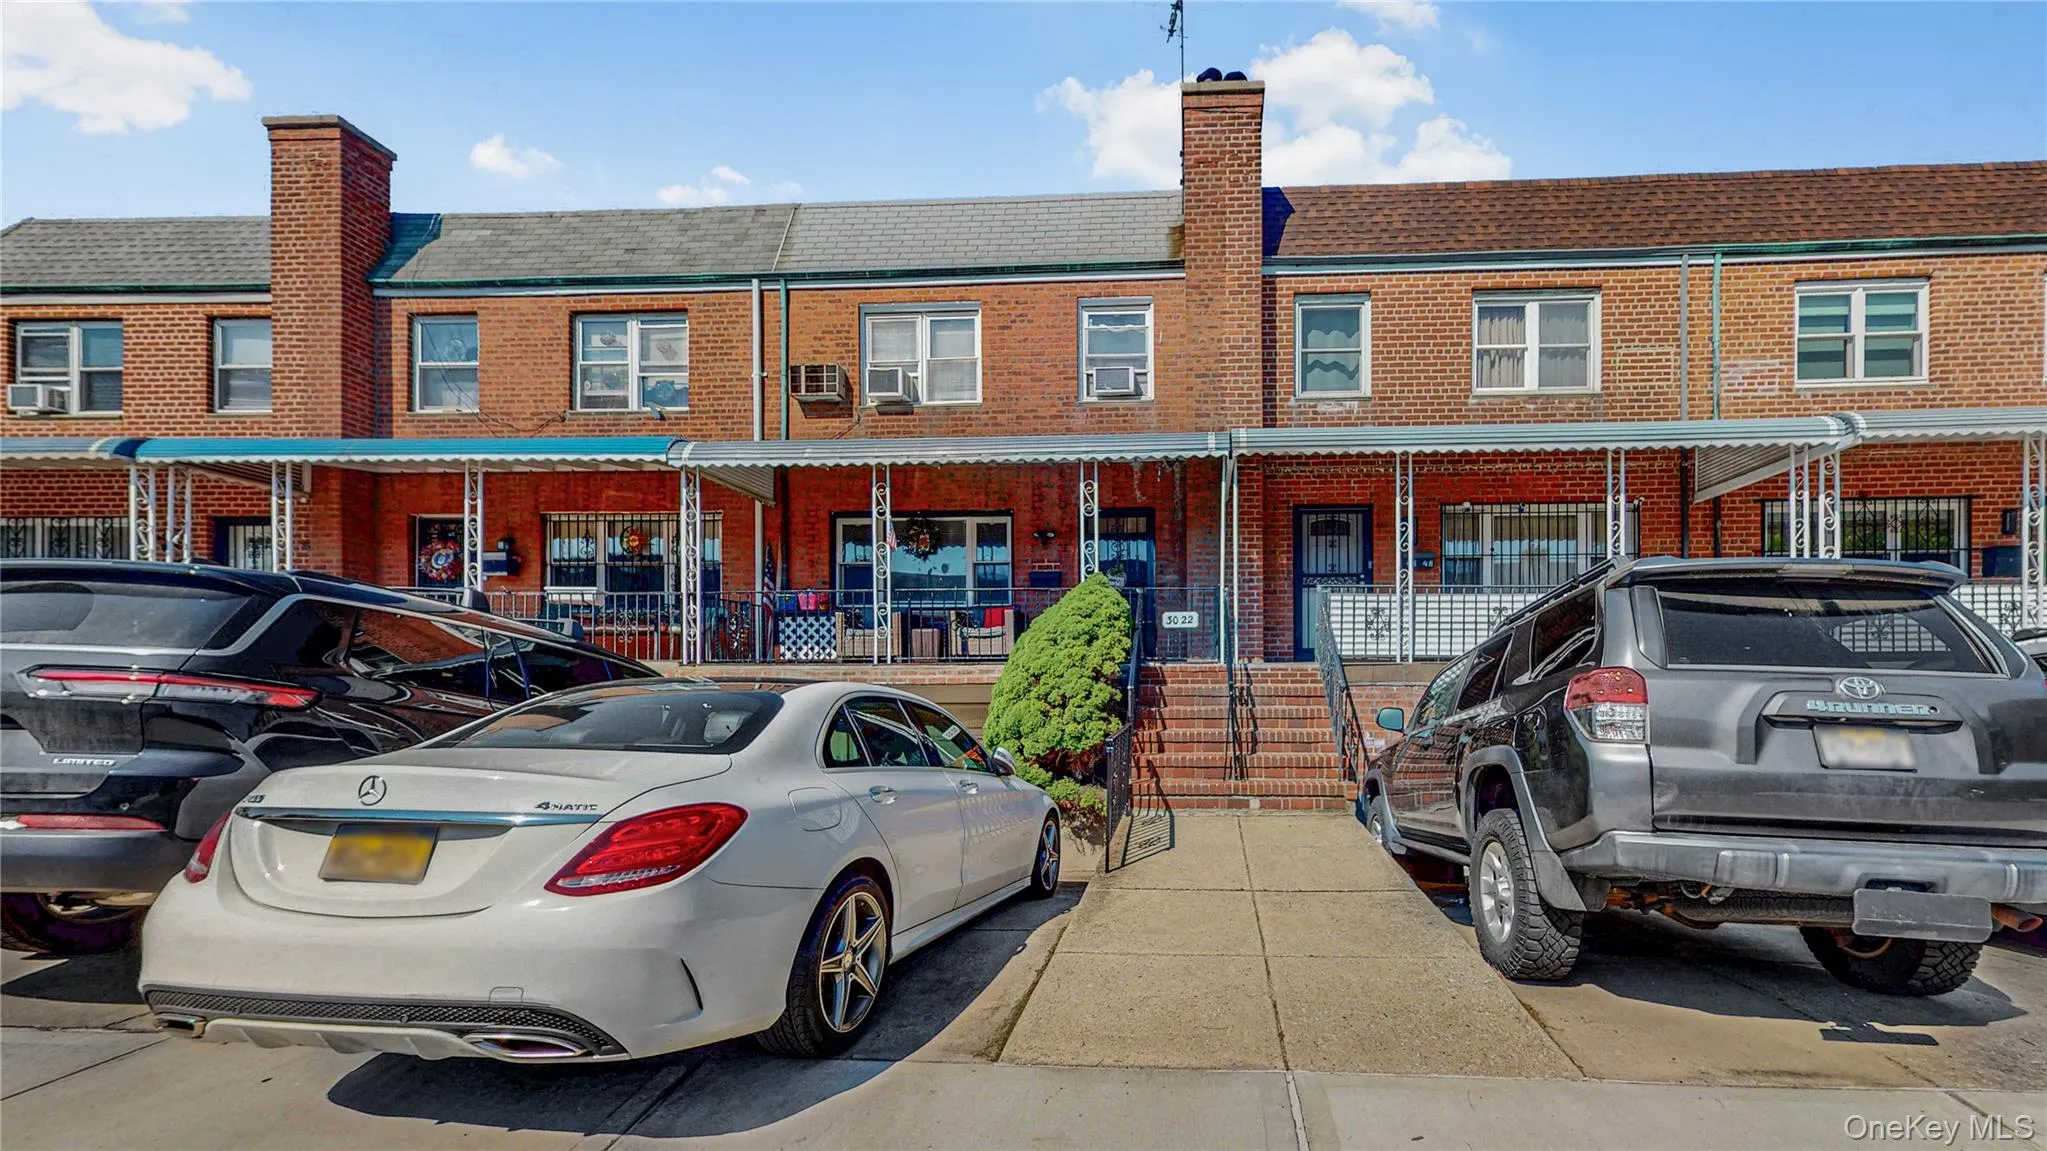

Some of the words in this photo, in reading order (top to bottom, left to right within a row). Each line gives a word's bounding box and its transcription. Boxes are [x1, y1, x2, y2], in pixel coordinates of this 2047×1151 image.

[1807, 700, 1930, 715] 4RUNNER
[53, 758, 116, 766] LIMITED
[535, 801, 598, 810] 4MATIC
